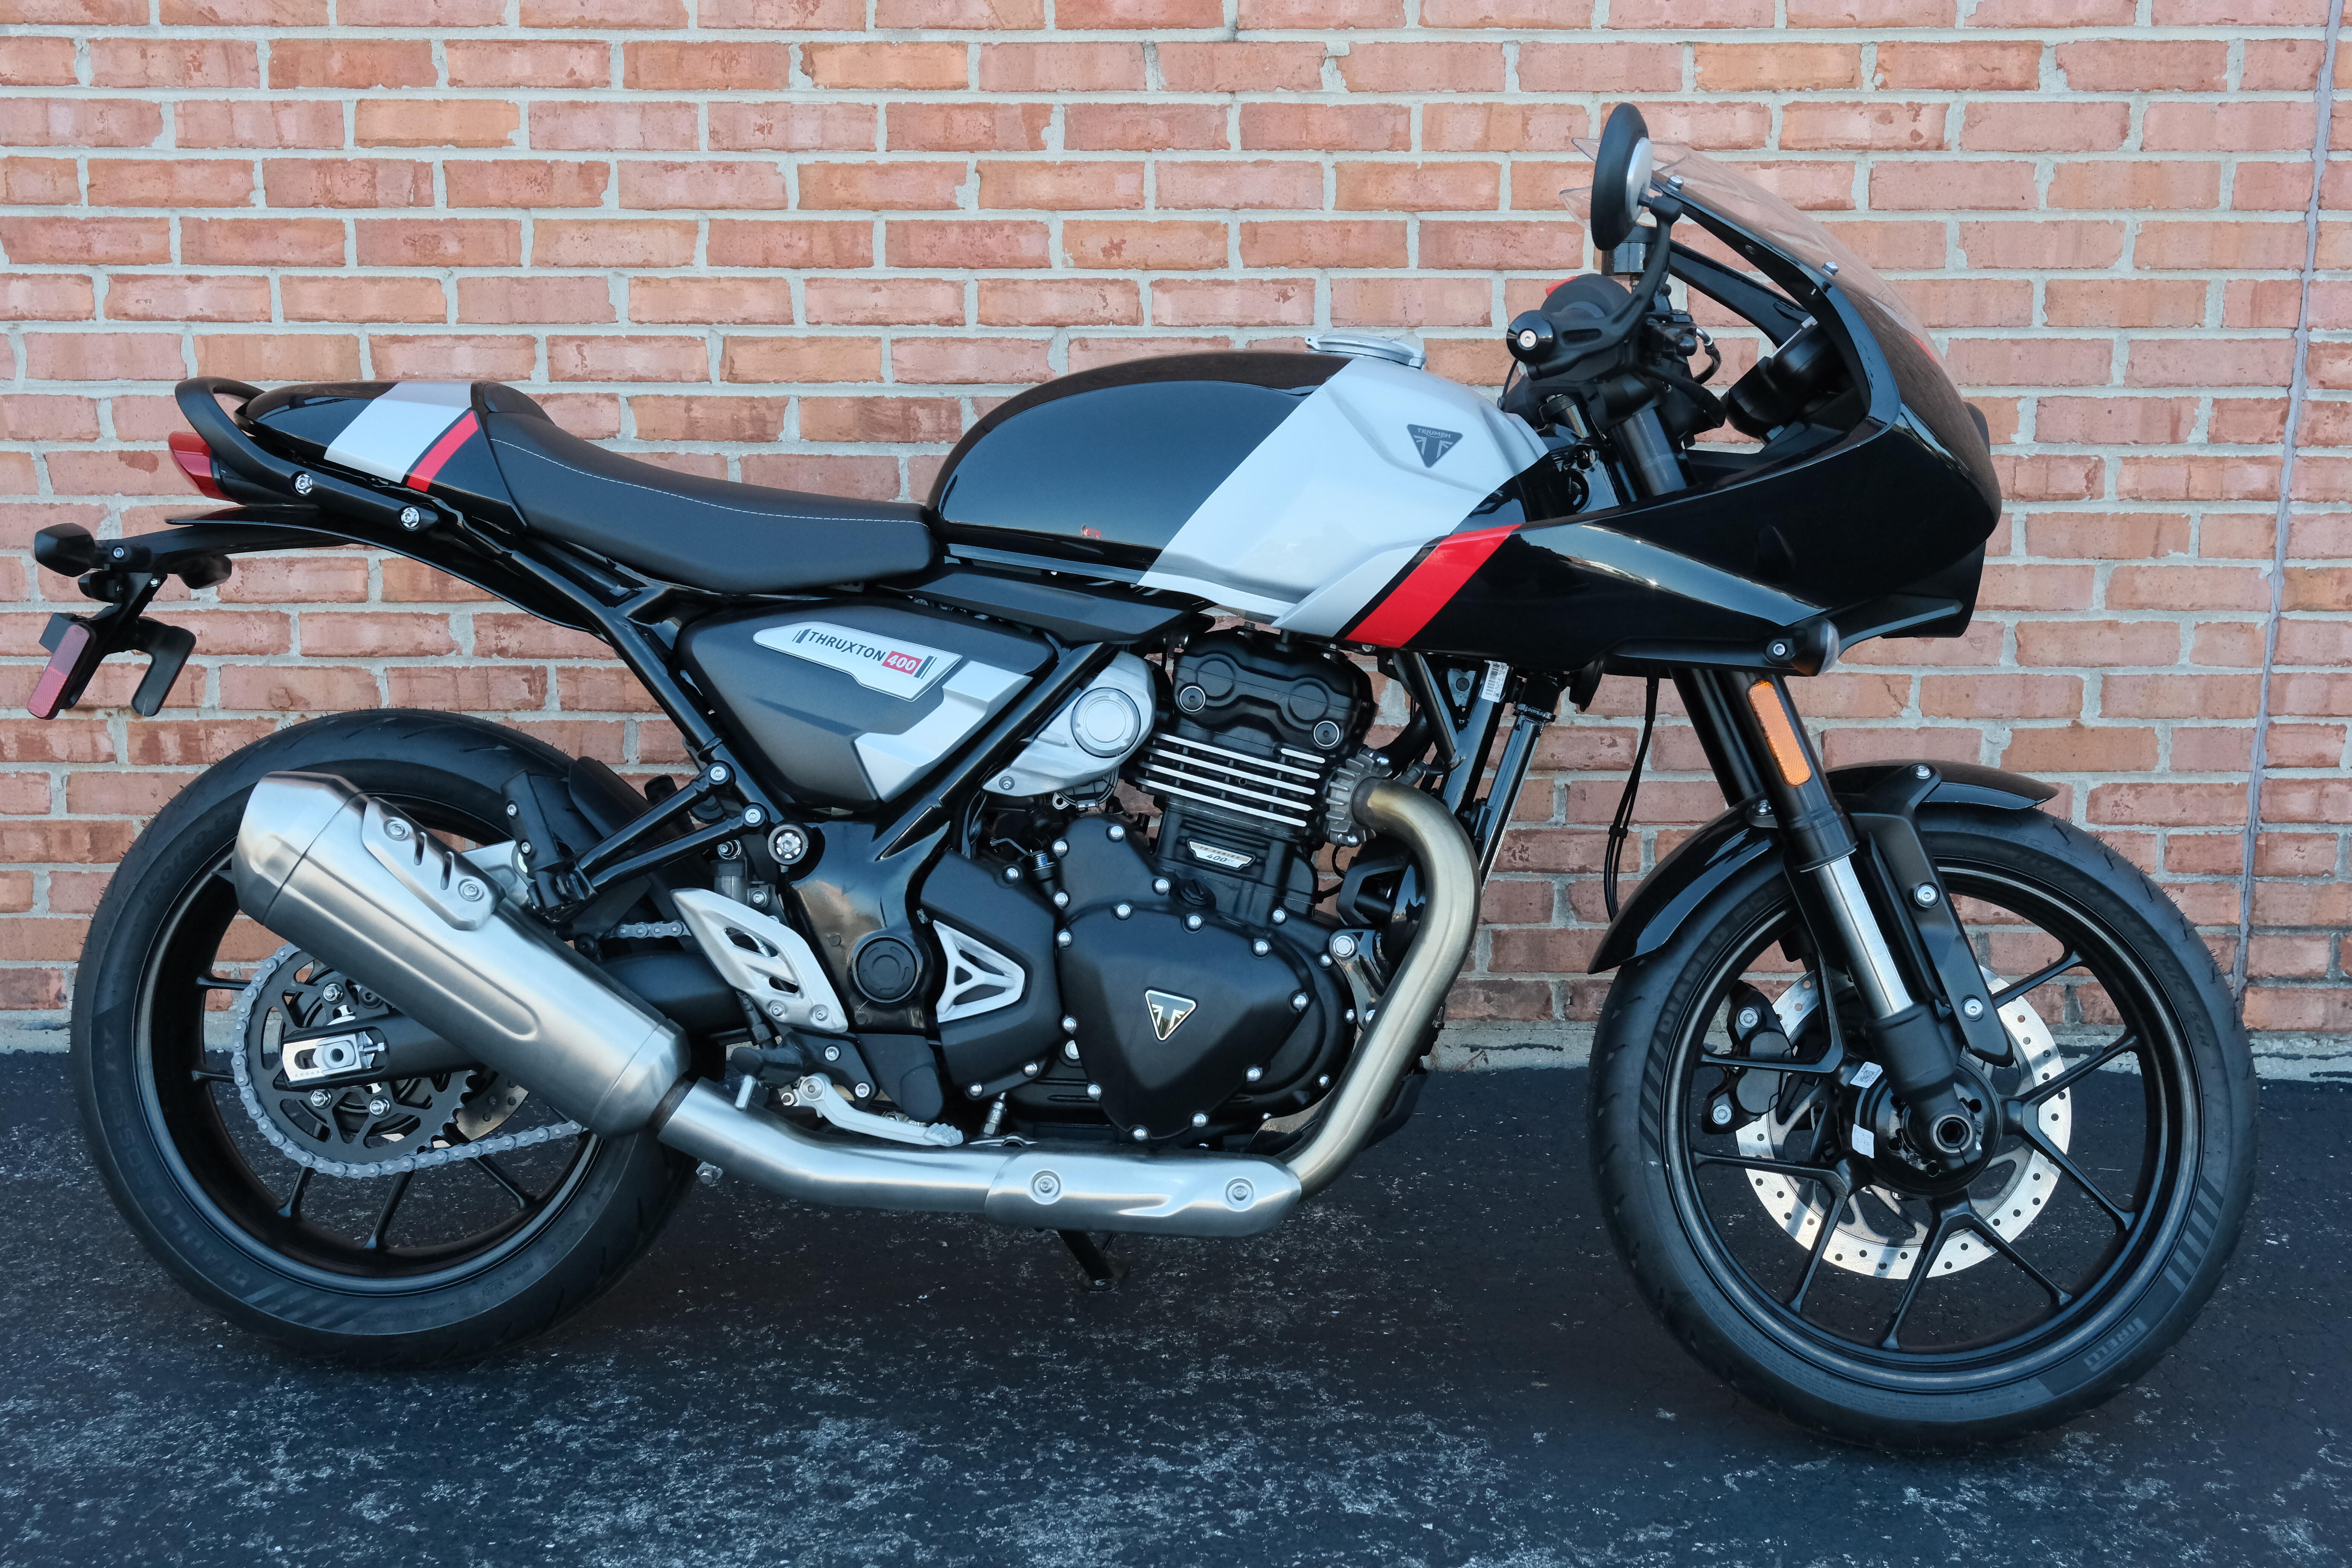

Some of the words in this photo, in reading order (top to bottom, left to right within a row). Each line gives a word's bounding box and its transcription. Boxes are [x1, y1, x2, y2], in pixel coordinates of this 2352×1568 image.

[1417, 428, 1451, 438] TRIUMPH
[809, 631, 886, 661] THRUXTON
[888, 654, 917, 671] 400
[1212, 850, 1240, 859] SERIES
[1658, 925, 1729, 1033] DIABLO
[151, 1193, 249, 1289] DIABLO
[2083, 1317, 2148, 1372] PIRELLI
